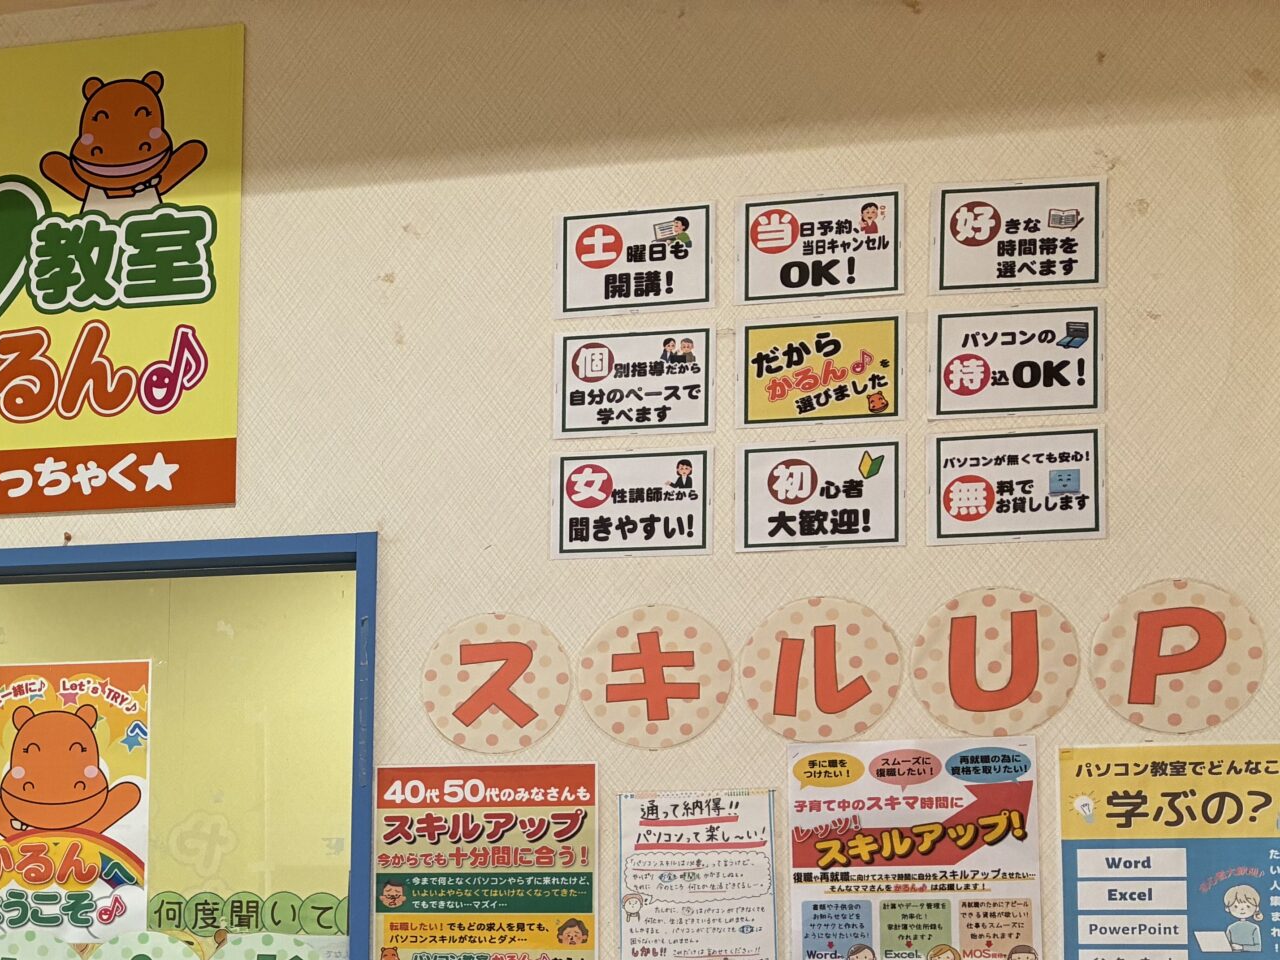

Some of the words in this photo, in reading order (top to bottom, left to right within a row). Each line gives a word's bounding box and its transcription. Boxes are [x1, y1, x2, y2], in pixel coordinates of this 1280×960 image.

[955, 204, 1041, 245] 好きな
[579, 227, 690, 264] 土曜日も
[802, 236, 889, 256] 当日キャンセル
[997, 237, 1078, 258] 時間帯を
[29, 204, 217, 316] 教室
[997, 258, 1078, 279] 選べます
[780, 256, 856, 288] OK!
[604, 271, 674, 299] 開講!
[961, 329, 1057, 349] パソコンの
[574, 346, 701, 383] 個別指導だから
[752, 331, 842, 376] だから
[569, 383, 701, 407] 自分のペースで
[794, 373, 889, 415] 選びました
[597, 404, 672, 424] 学べます
[943, 450, 1090, 469] パソコンが無くても安心!
[569, 468, 699, 506] 女性講師だから
[771, 463, 864, 502] 初心者
[995, 493, 1090, 514] お貸しします
[569, 513, 695, 543] 聞きやすい!
[768, 508, 871, 538] 大歓迎!
[808, 759, 848, 769] 手に職を
[881, 756, 932, 767] スムーズに
[950, 763, 1028, 776] 資格を取りたい!
[958, 753, 1022, 765] 再就職の為に
[1075, 759, 1280, 778] パソコン教室でどんなこ
[803, 769, 852, 780] つけたい!
[875, 766, 935, 778] 復職したい!
[384, 780, 440, 804] 40代
[443, 778, 590, 803] 50代のみなさんも
[640, 798, 740, 821] 通って納得!!
[793, 796, 964, 813] 子育て中のスキマ時間に
[1106, 789, 1273, 829] 学ぶの?
[382, 809, 588, 845] スキルアップ
[793, 814, 862, 843] レッツ!
[815, 808, 1028, 870] スキルアップ!
[377, 845, 588, 869] 今からでも十分間に合う!
[1105, 856, 1152, 870] Word
[1107, 888, 1153, 902] Excel
[155, 897, 335, 931] 何度聞いて
[809, 922, 865, 930] サクサクと作れる
[966, 922, 1025, 930] 仕事もスムーズに
[1088, 923, 1180, 937] PowerPoint
